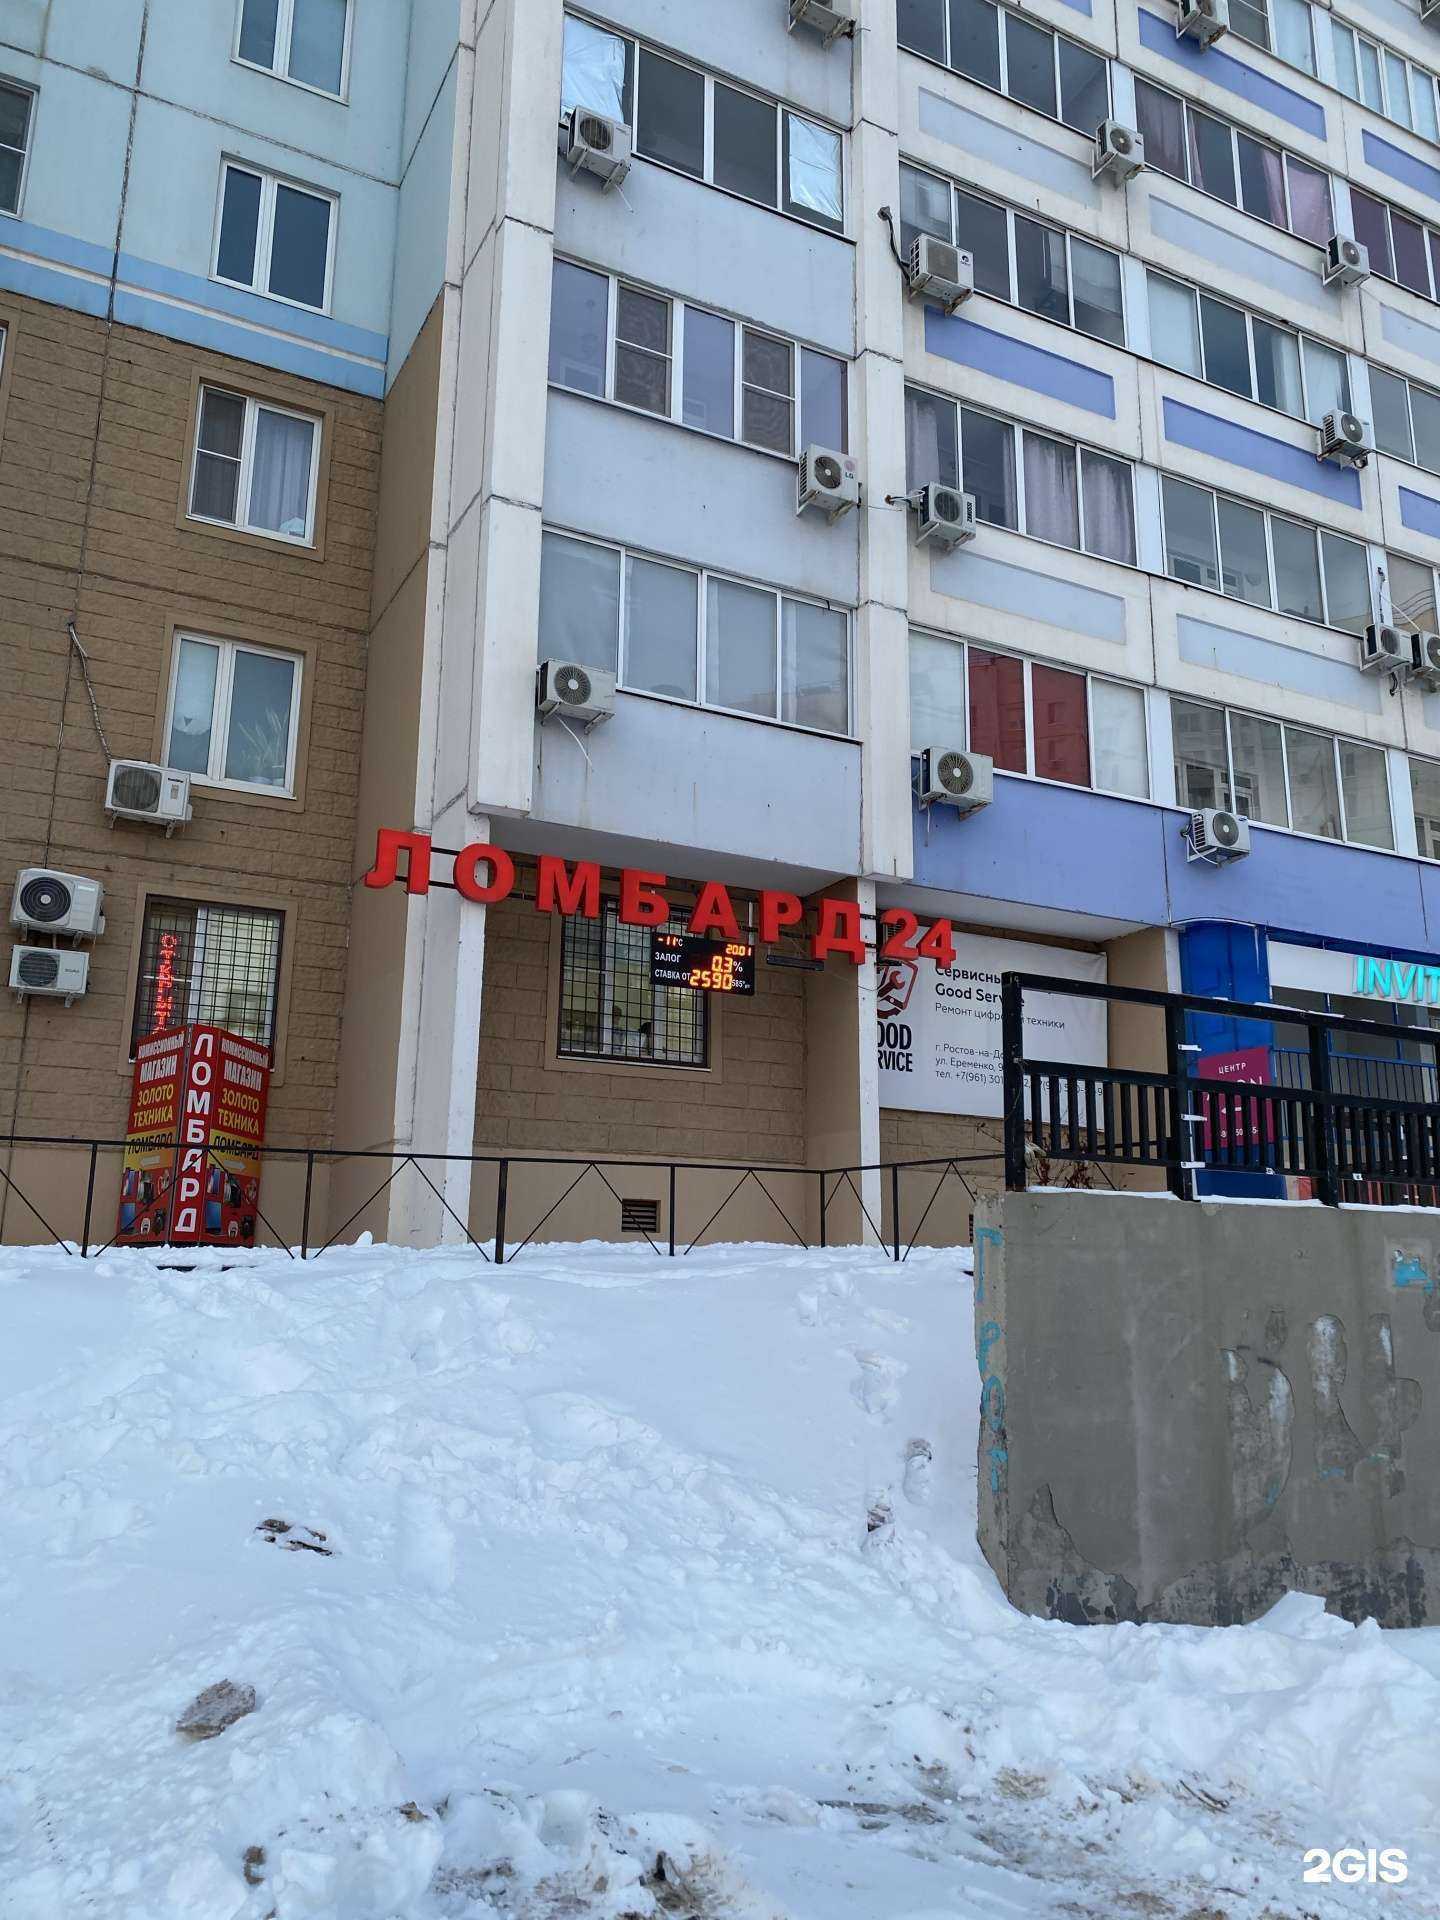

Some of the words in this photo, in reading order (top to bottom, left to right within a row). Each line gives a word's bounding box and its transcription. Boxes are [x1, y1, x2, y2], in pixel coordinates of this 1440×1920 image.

[845, 471, 854, 479] LG
[364, 828, 866, 965] ЛОМБАРД
[879, 907, 957, 968] 24
[654, 951, 682, 963] ЗАЛОГ
[654, 968, 680, 979] СТАВКА
[681, 972, 691, 981] ОТ
[689, 969, 733, 990] 2590
[935, 982, 972, 1000] Good
[935, 1002, 972, 1016] Ремонт
[1026, 1016, 1065, 1030] техники
[876, 1020, 912, 1050] OOD
[139, 1054, 178, 1084] МАГАЗИН
[877, 1049, 913, 1073] RVICE
[935, 1057, 949, 1068] ул.
[950, 1059, 996, 1072] Еременко,
[1218, 1062, 1247, 1075] ЦЕНТР
[223, 1059, 263, 1092] МАГАЗИН
[137, 1083, 174, 1107] ЗОЛОТО
[221, 1087, 260, 1115] ЗОЛОТО
[133, 1106, 173, 1128] ТЕХНИКА
[217, 1109, 260, 1136] ТЕХНИКА
[175, 1033, 214, 1233] ЛОМБАРД
